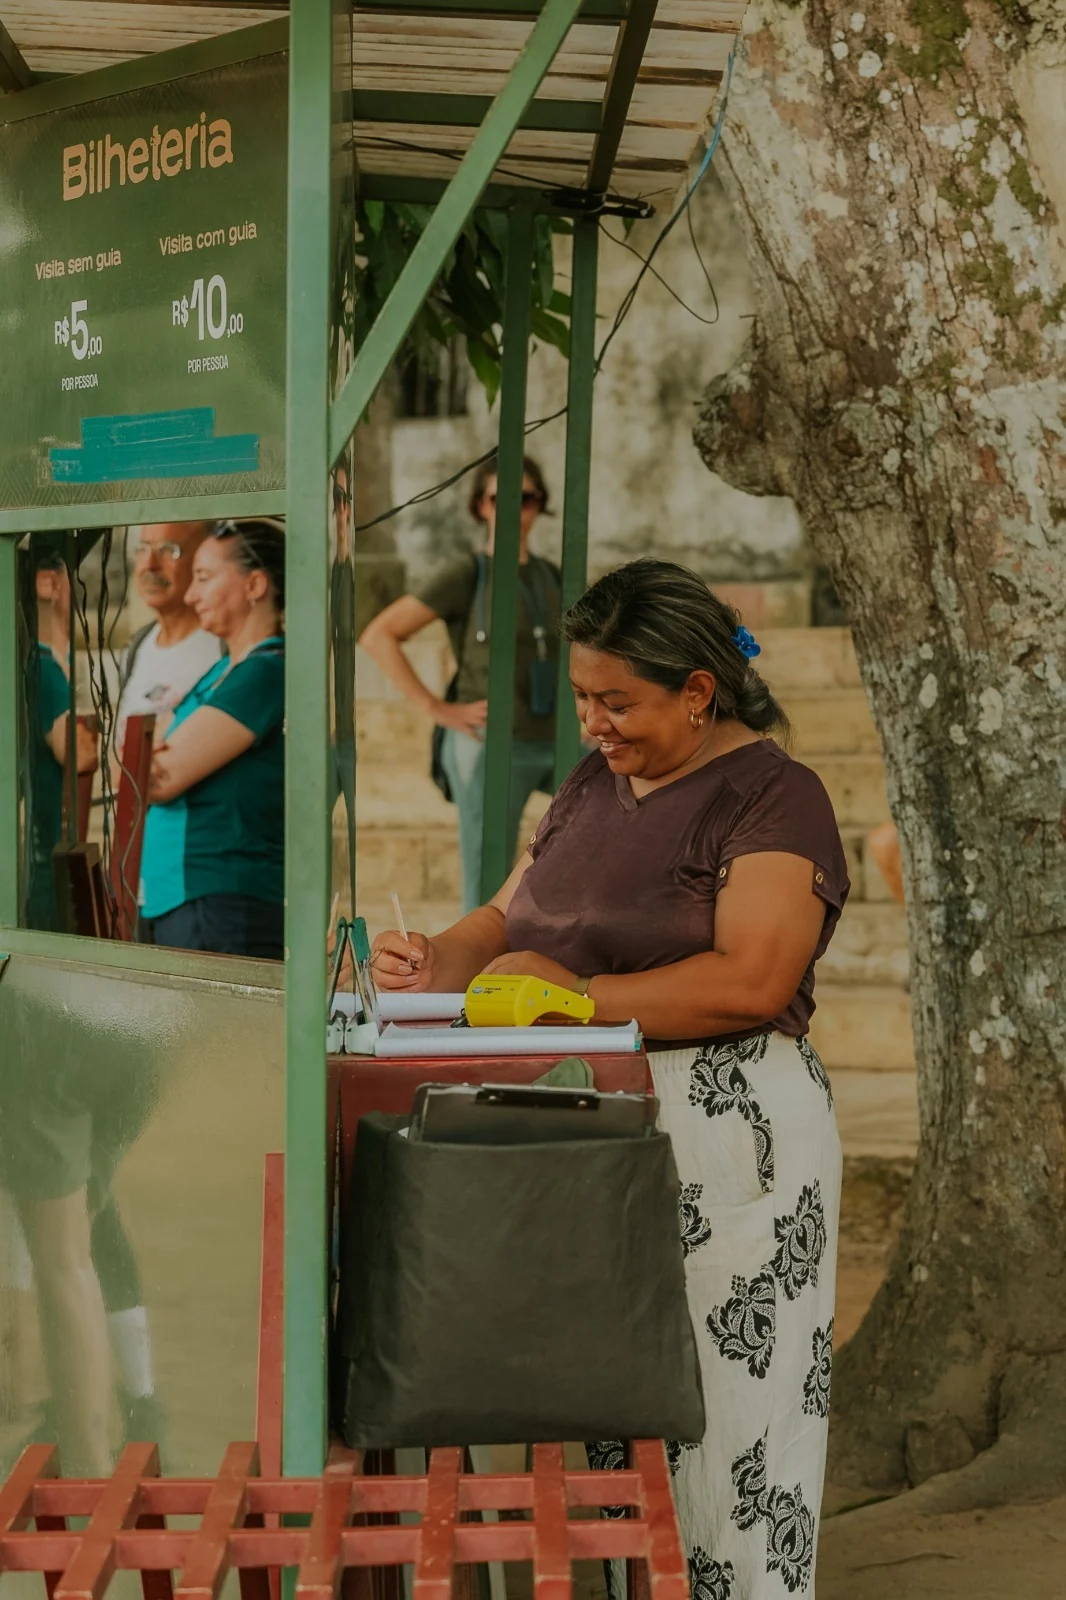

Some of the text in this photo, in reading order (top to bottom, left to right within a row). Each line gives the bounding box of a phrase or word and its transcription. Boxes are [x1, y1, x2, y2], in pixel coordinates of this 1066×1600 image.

[63, 112, 233, 201] Bilheteria
[159, 220, 257, 256] Visita com guia
[35, 248, 121, 281] Visita sem guia
[187, 355, 229, 374] POR PESSOA
[61, 373, 98, 391] POR PESSOA
